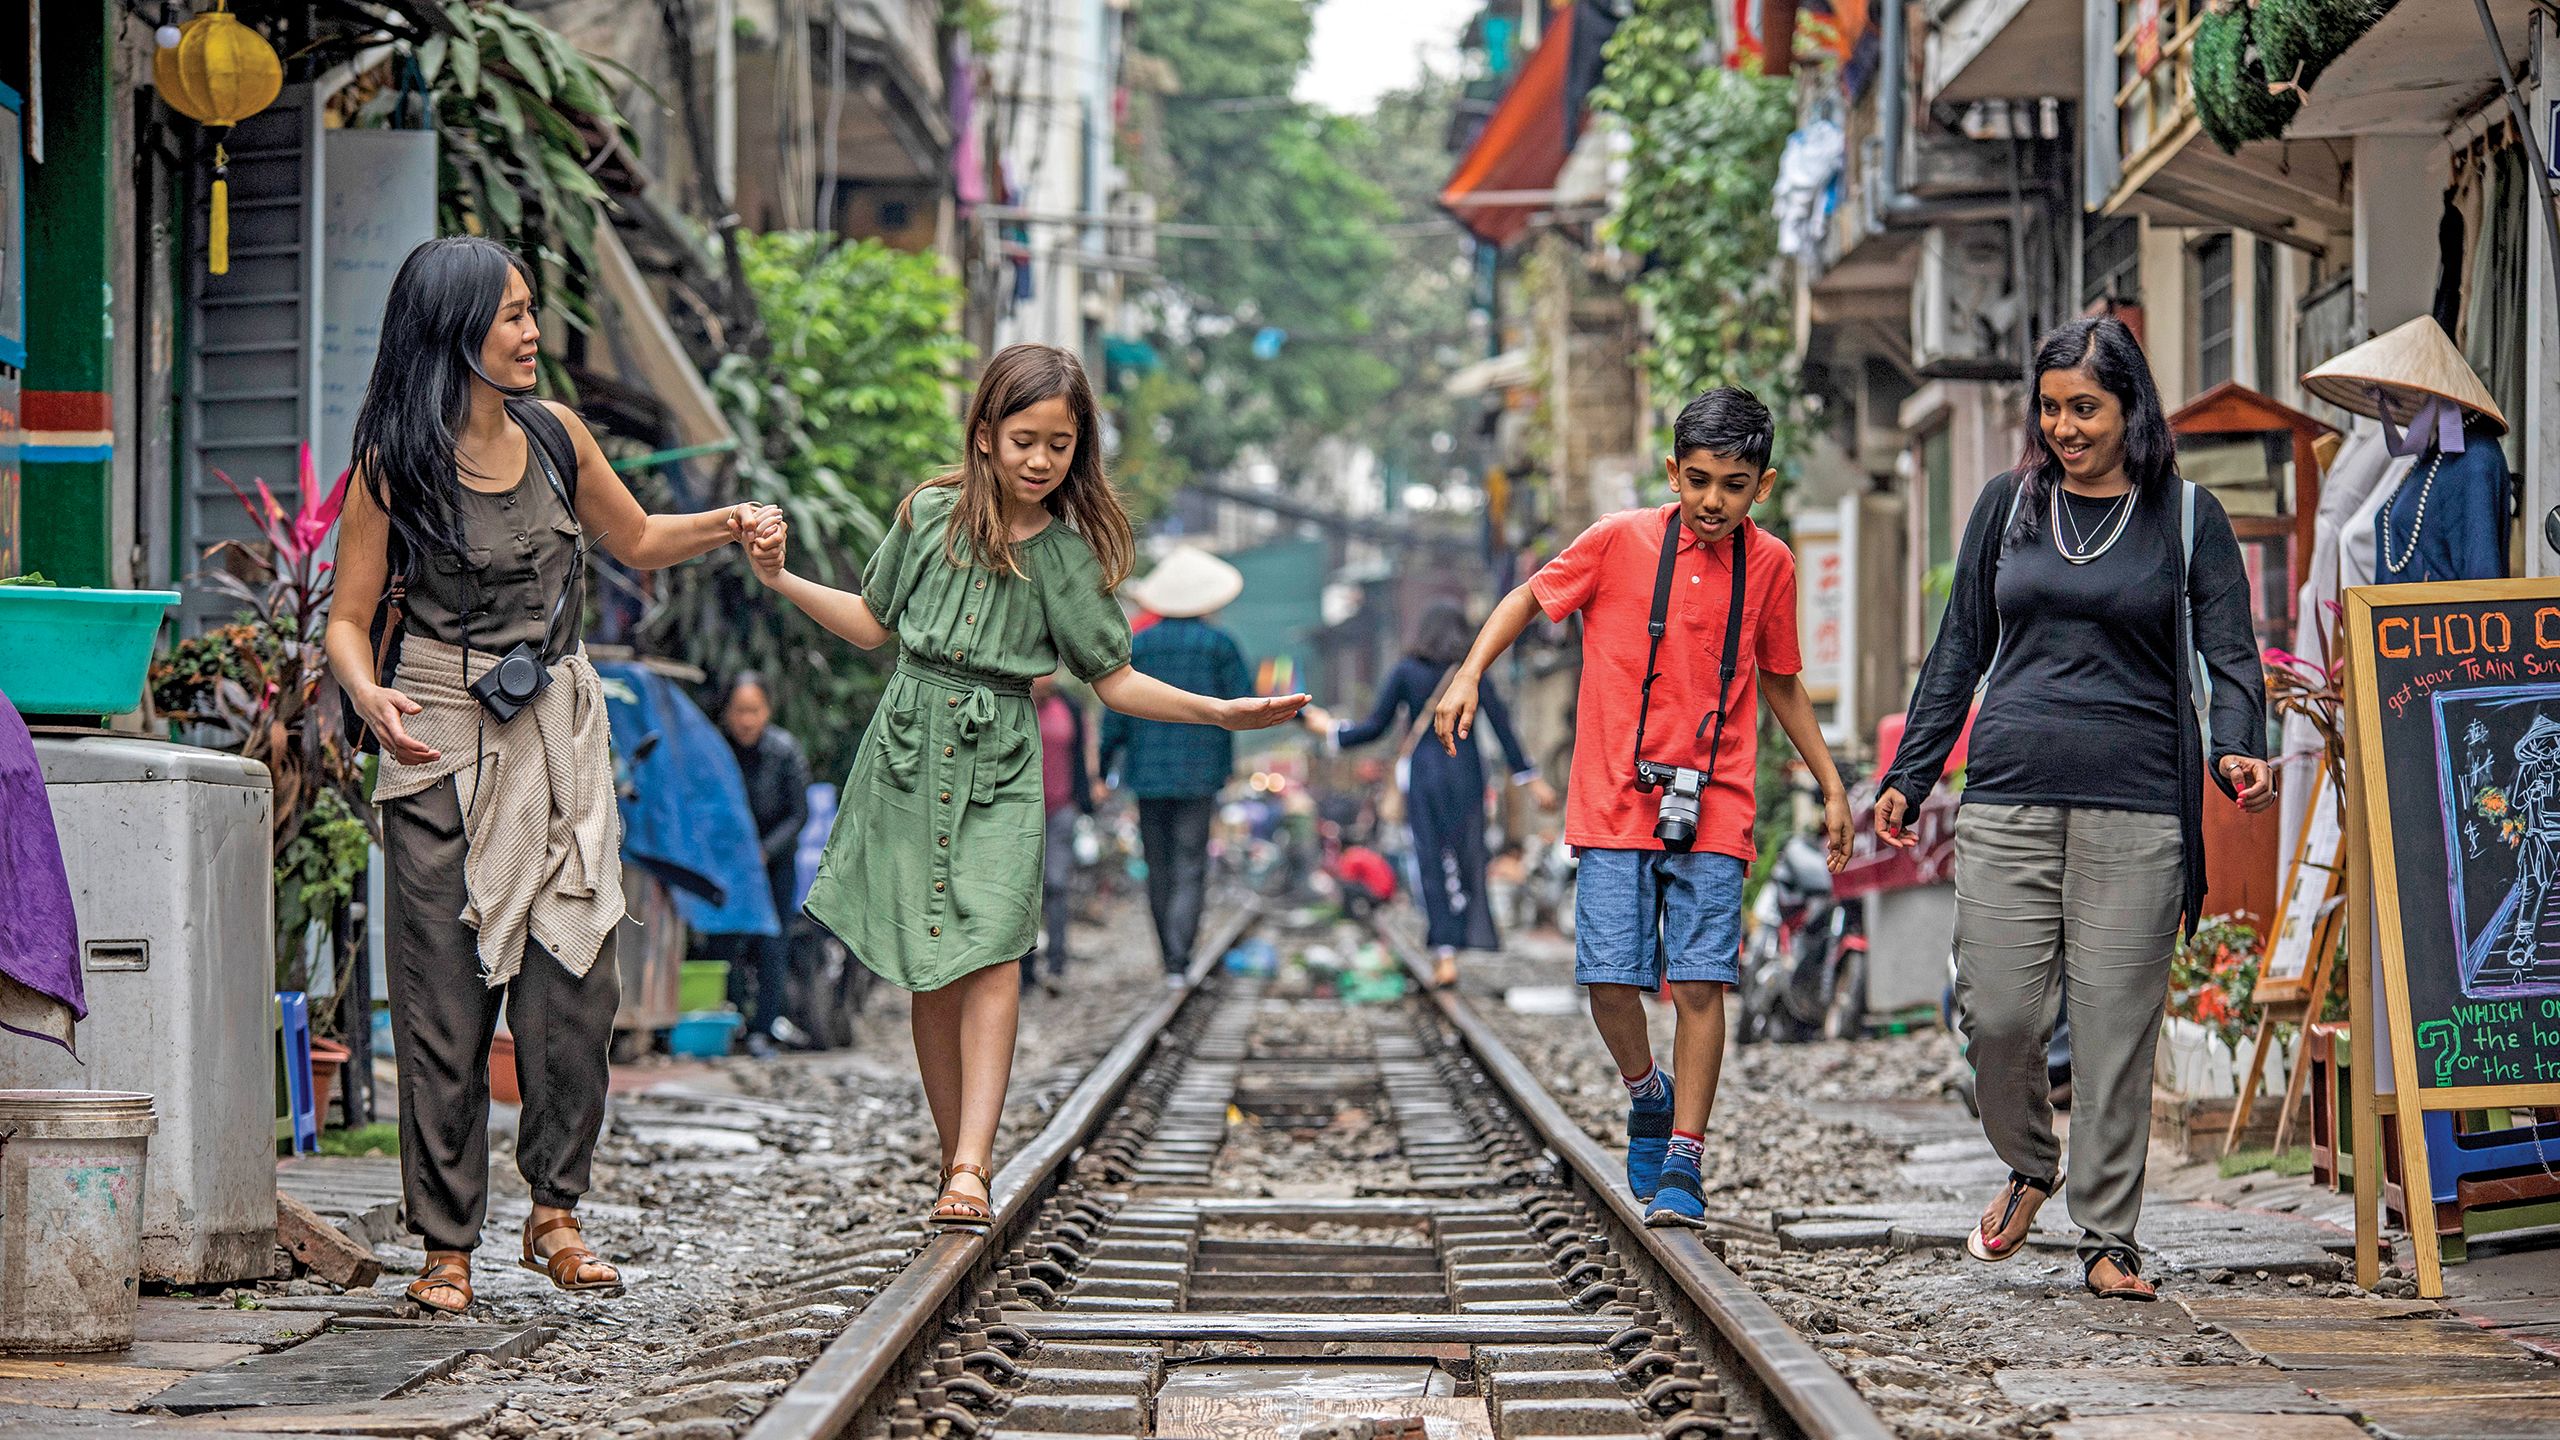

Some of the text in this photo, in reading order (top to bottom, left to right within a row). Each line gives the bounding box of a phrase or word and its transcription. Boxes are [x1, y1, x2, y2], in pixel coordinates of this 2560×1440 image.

[2377, 611, 2512, 660] CHOO
[2387, 682, 2412, 719] get
[2413, 668, 2455, 697] your
[2451, 1001, 2524, 1028] WHICH
[2472, 1025, 2521, 1052] the
[2457, 1055, 2480, 1071] or
[2482, 1055, 2525, 1083] the
